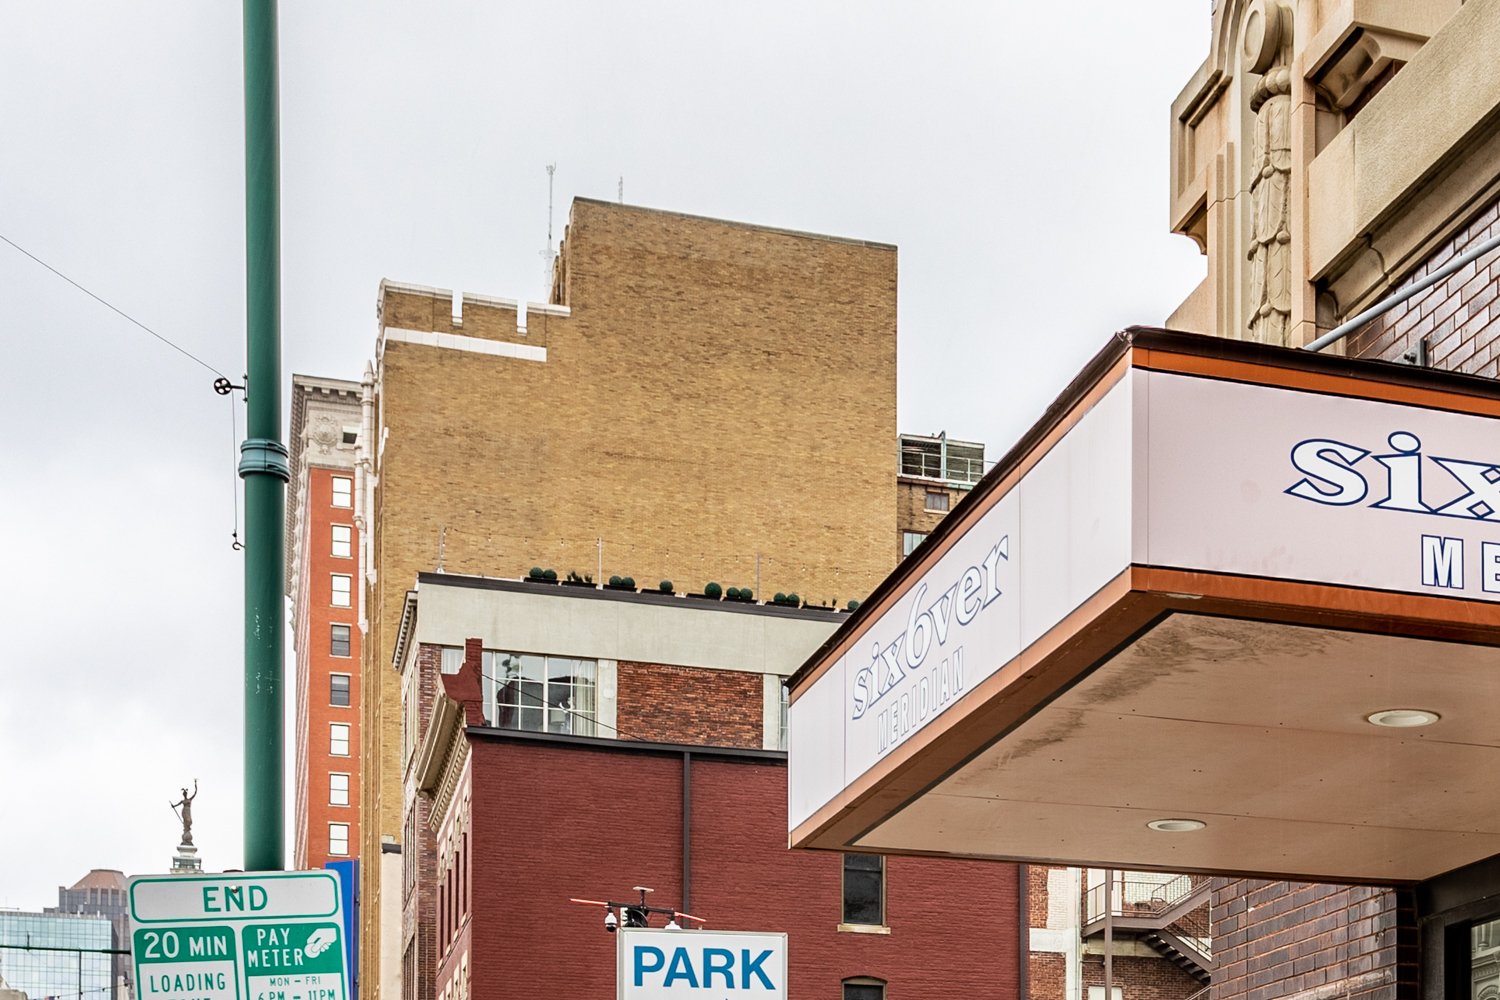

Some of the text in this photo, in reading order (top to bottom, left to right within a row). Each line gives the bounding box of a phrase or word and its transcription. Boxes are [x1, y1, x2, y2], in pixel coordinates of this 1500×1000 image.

[877, 646, 964, 755] MERIDIAN
[202, 885, 268, 912] END
[143, 931, 228, 958] 20 MIN
[257, 927, 290, 946] PAY
[248, 948, 304, 968] METER
[634, 945, 776, 990] PARK
[150, 972, 226, 993] LOADING
[270, 977, 290, 986] MON
[306, 976, 321, 985] FRI
